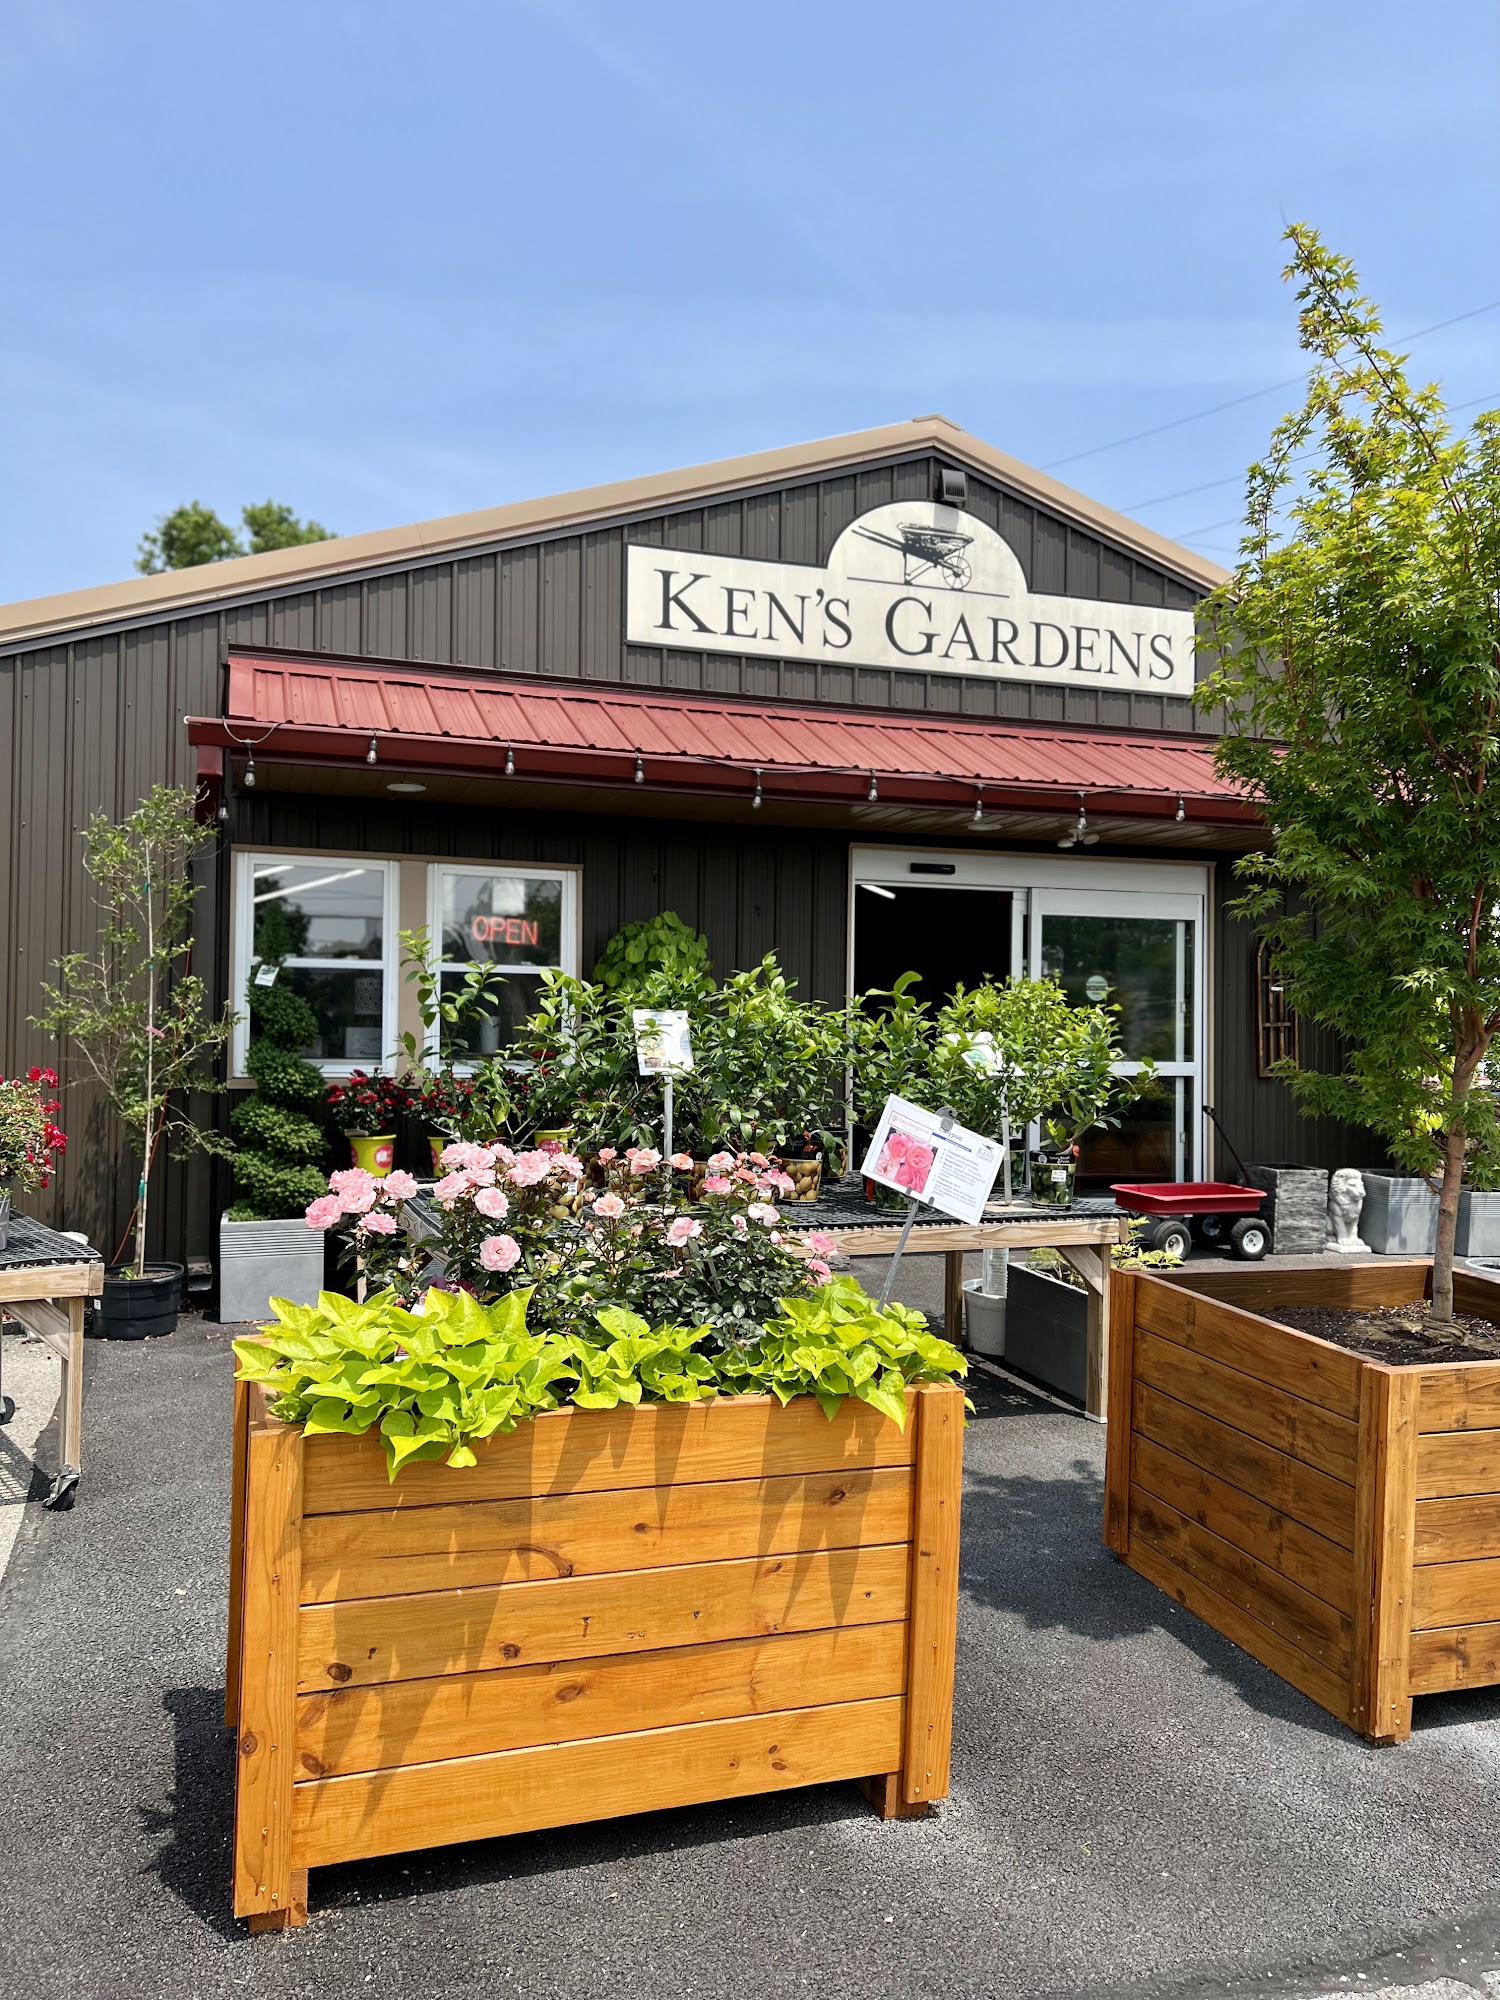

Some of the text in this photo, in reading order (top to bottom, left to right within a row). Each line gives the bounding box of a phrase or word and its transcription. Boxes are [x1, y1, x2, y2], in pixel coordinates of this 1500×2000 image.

[653, 569, 1174, 680] KEN'S GARDENS
[472, 915, 538, 945] OPEN
